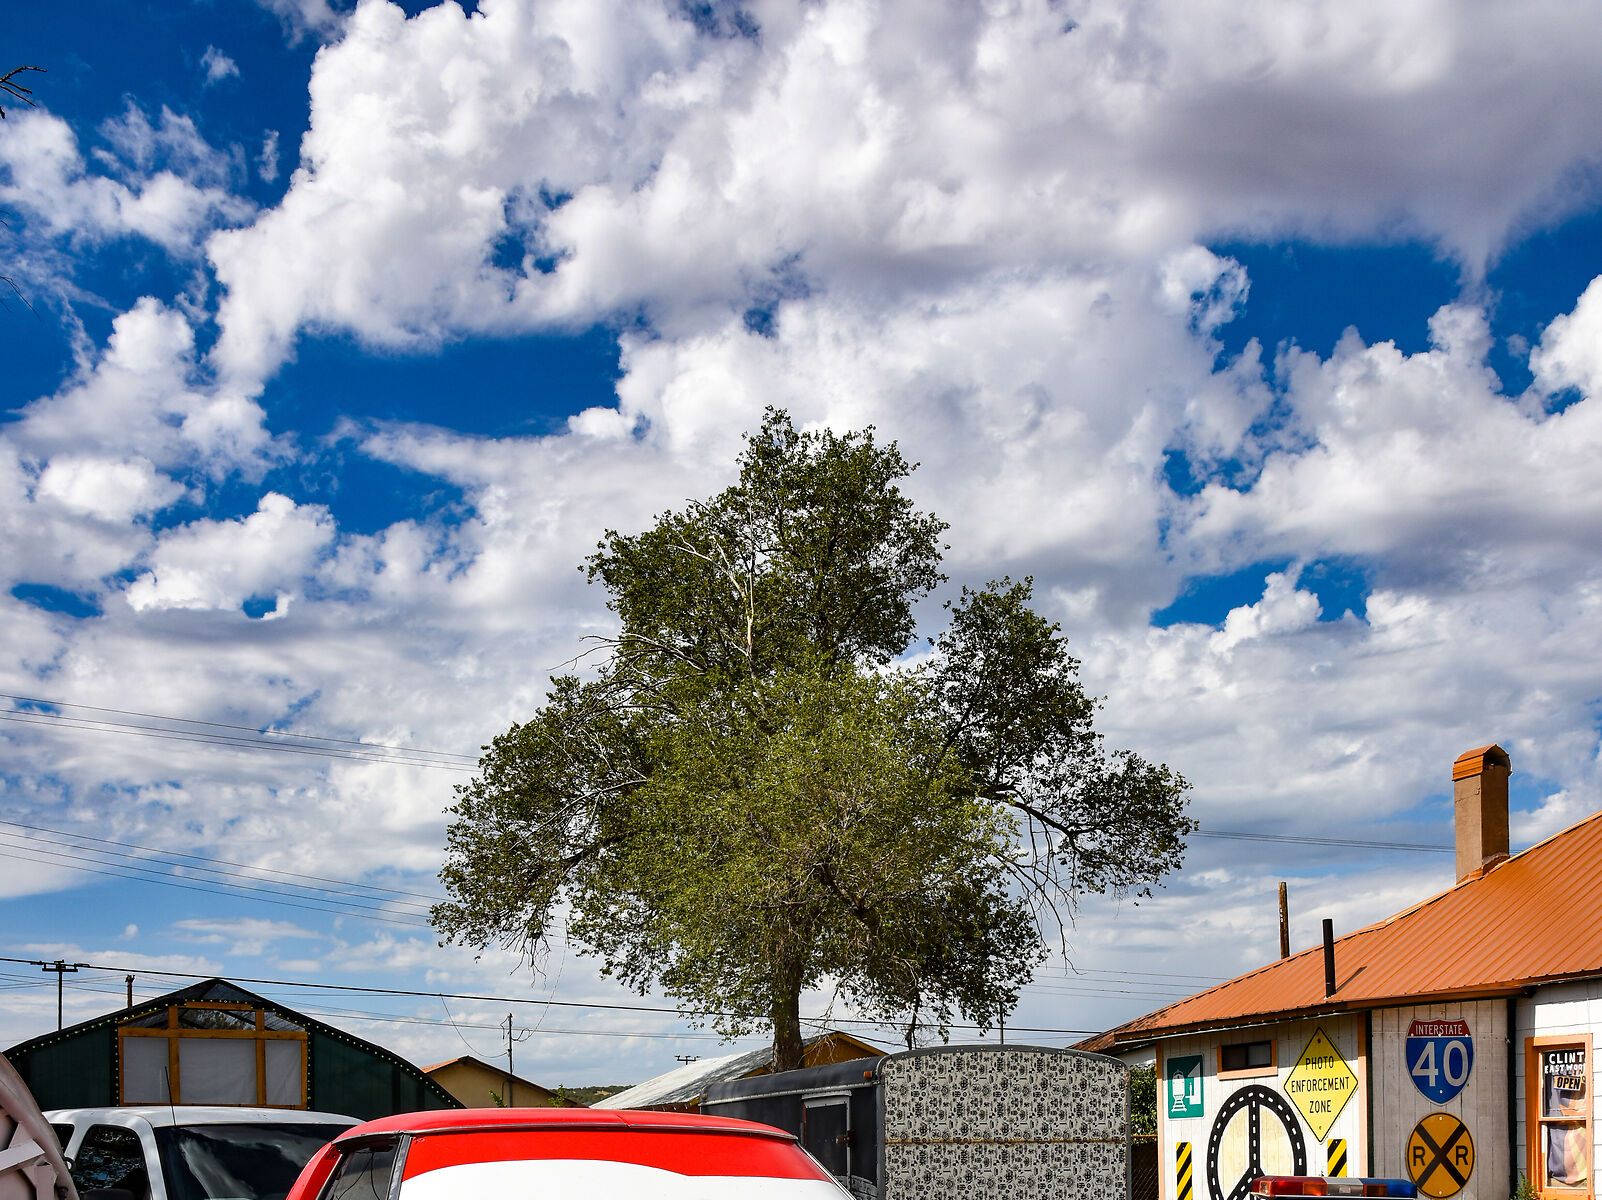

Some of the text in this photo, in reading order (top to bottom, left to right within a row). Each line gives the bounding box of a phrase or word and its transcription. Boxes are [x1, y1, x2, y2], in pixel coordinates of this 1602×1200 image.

[1415, 1024, 1463, 1036] INTERSTATE
[1305, 1056, 1335, 1071] PHOTO
[1411, 1040, 1469, 1087] 40
[1549, 1052, 1585, 1065] CLINT
[1291, 1076, 1350, 1093] ENFORCEMENT
[1557, 1077, 1581, 1090] OPEN
[1309, 1100, 1332, 1114] ZONE
